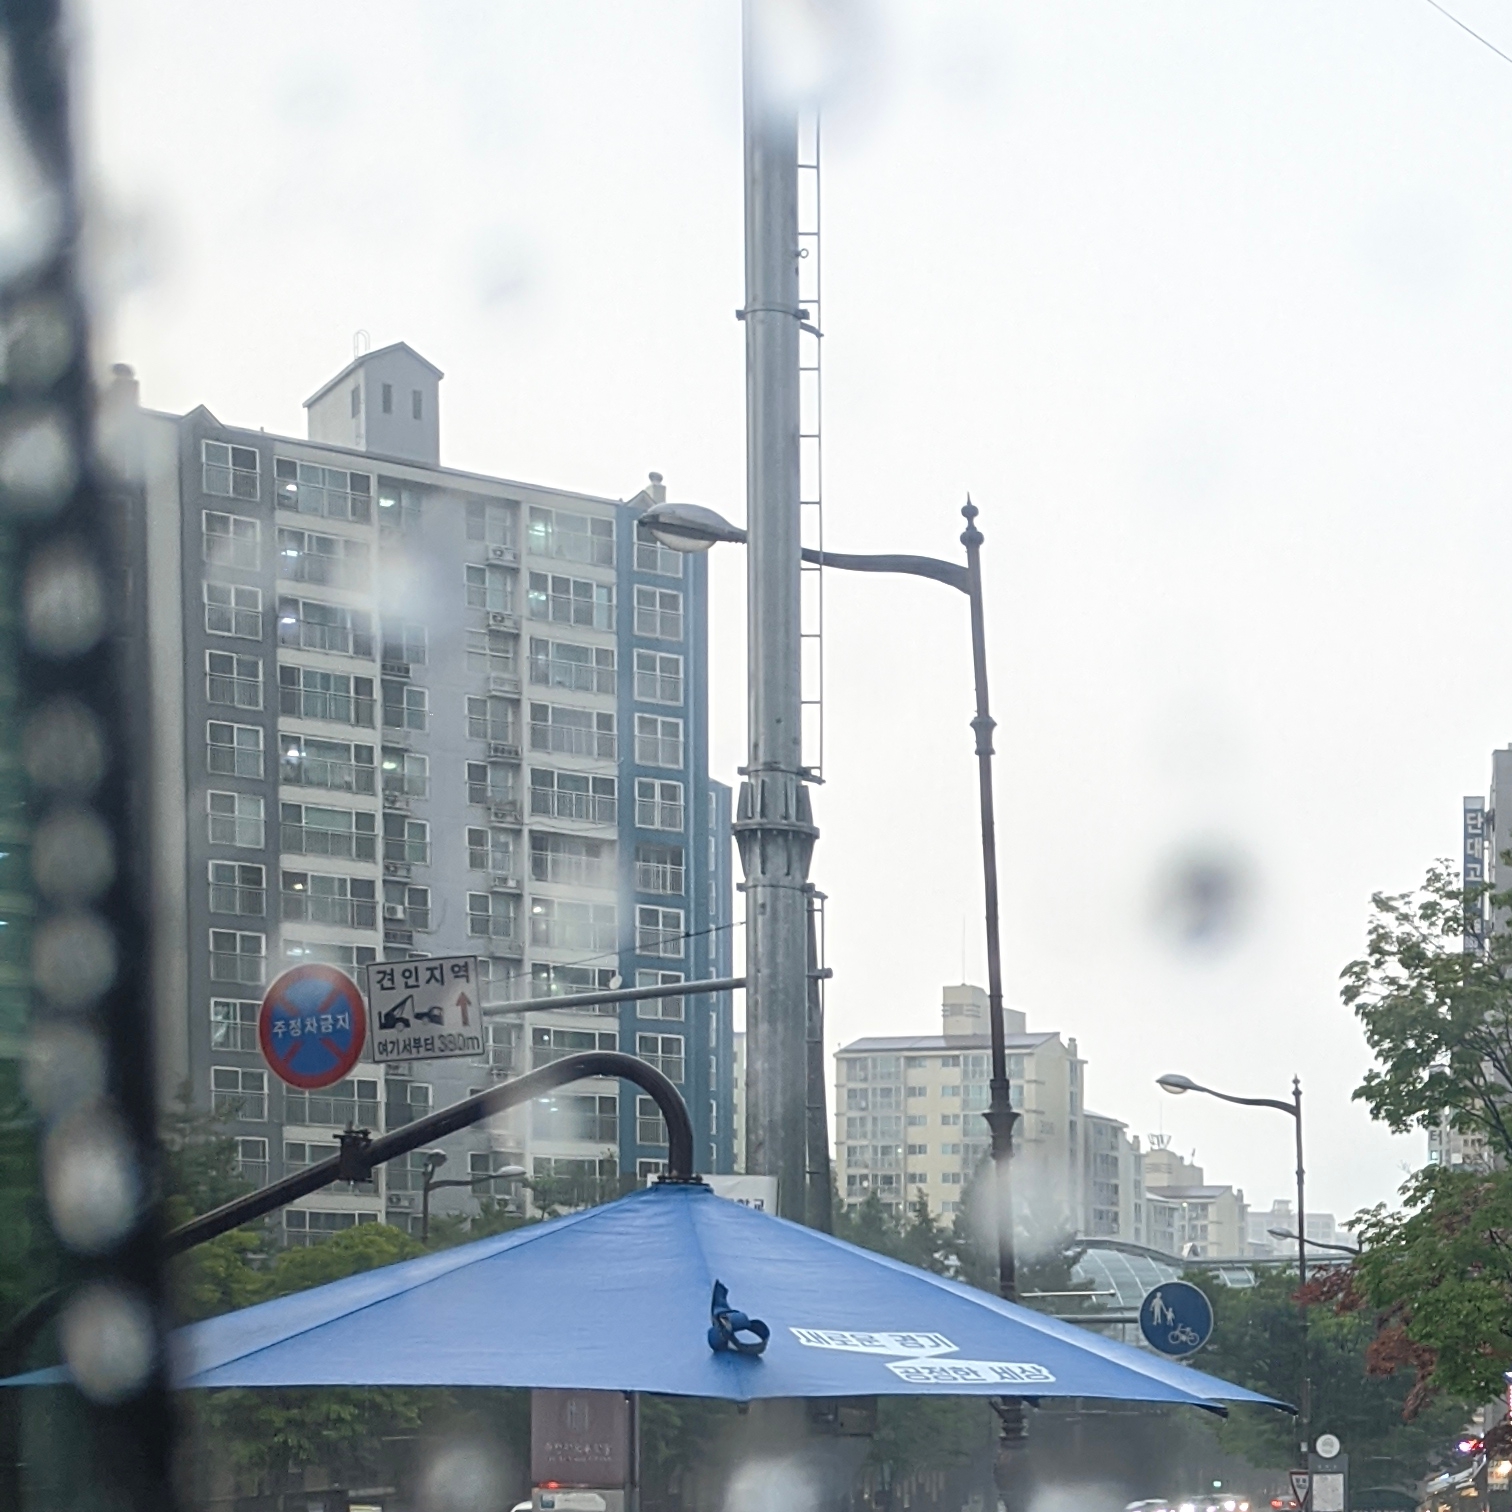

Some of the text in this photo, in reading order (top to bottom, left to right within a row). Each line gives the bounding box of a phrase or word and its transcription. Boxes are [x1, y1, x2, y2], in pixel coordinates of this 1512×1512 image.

[376, 961, 470, 991] 견인지역
[273, 1012, 349, 1038] 주정차금지
[377, 1037, 435, 1057] 여기서부터
[797, 1328, 951, 1349] 새로운 경기
[894, 1365, 1049, 1382] 공정한 세상
